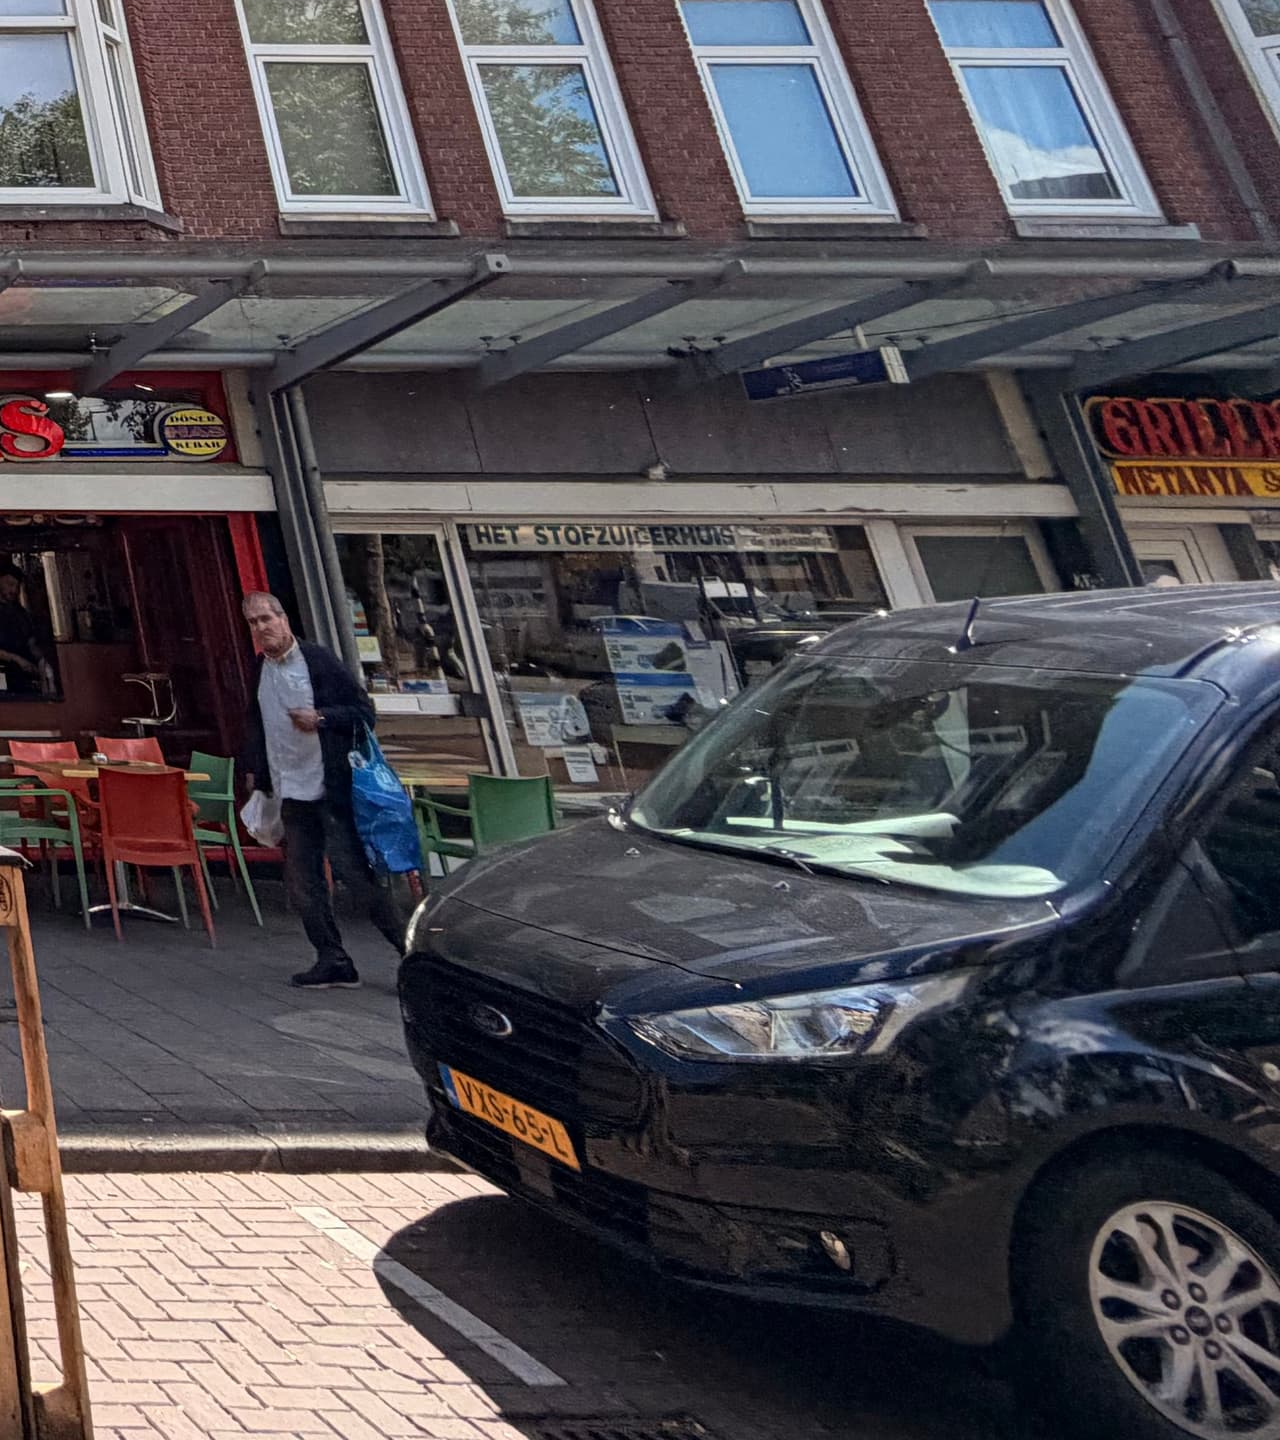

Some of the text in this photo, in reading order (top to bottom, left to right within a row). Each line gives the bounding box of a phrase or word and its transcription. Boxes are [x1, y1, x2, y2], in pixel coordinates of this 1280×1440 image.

[1115, 466, 1255, 496] NETANYA
[473, 524, 520, 545] HET
[533, 524, 736, 546] STOFZUIGERHUIS
[457, 1075, 569, 1158] VXS-65-L
